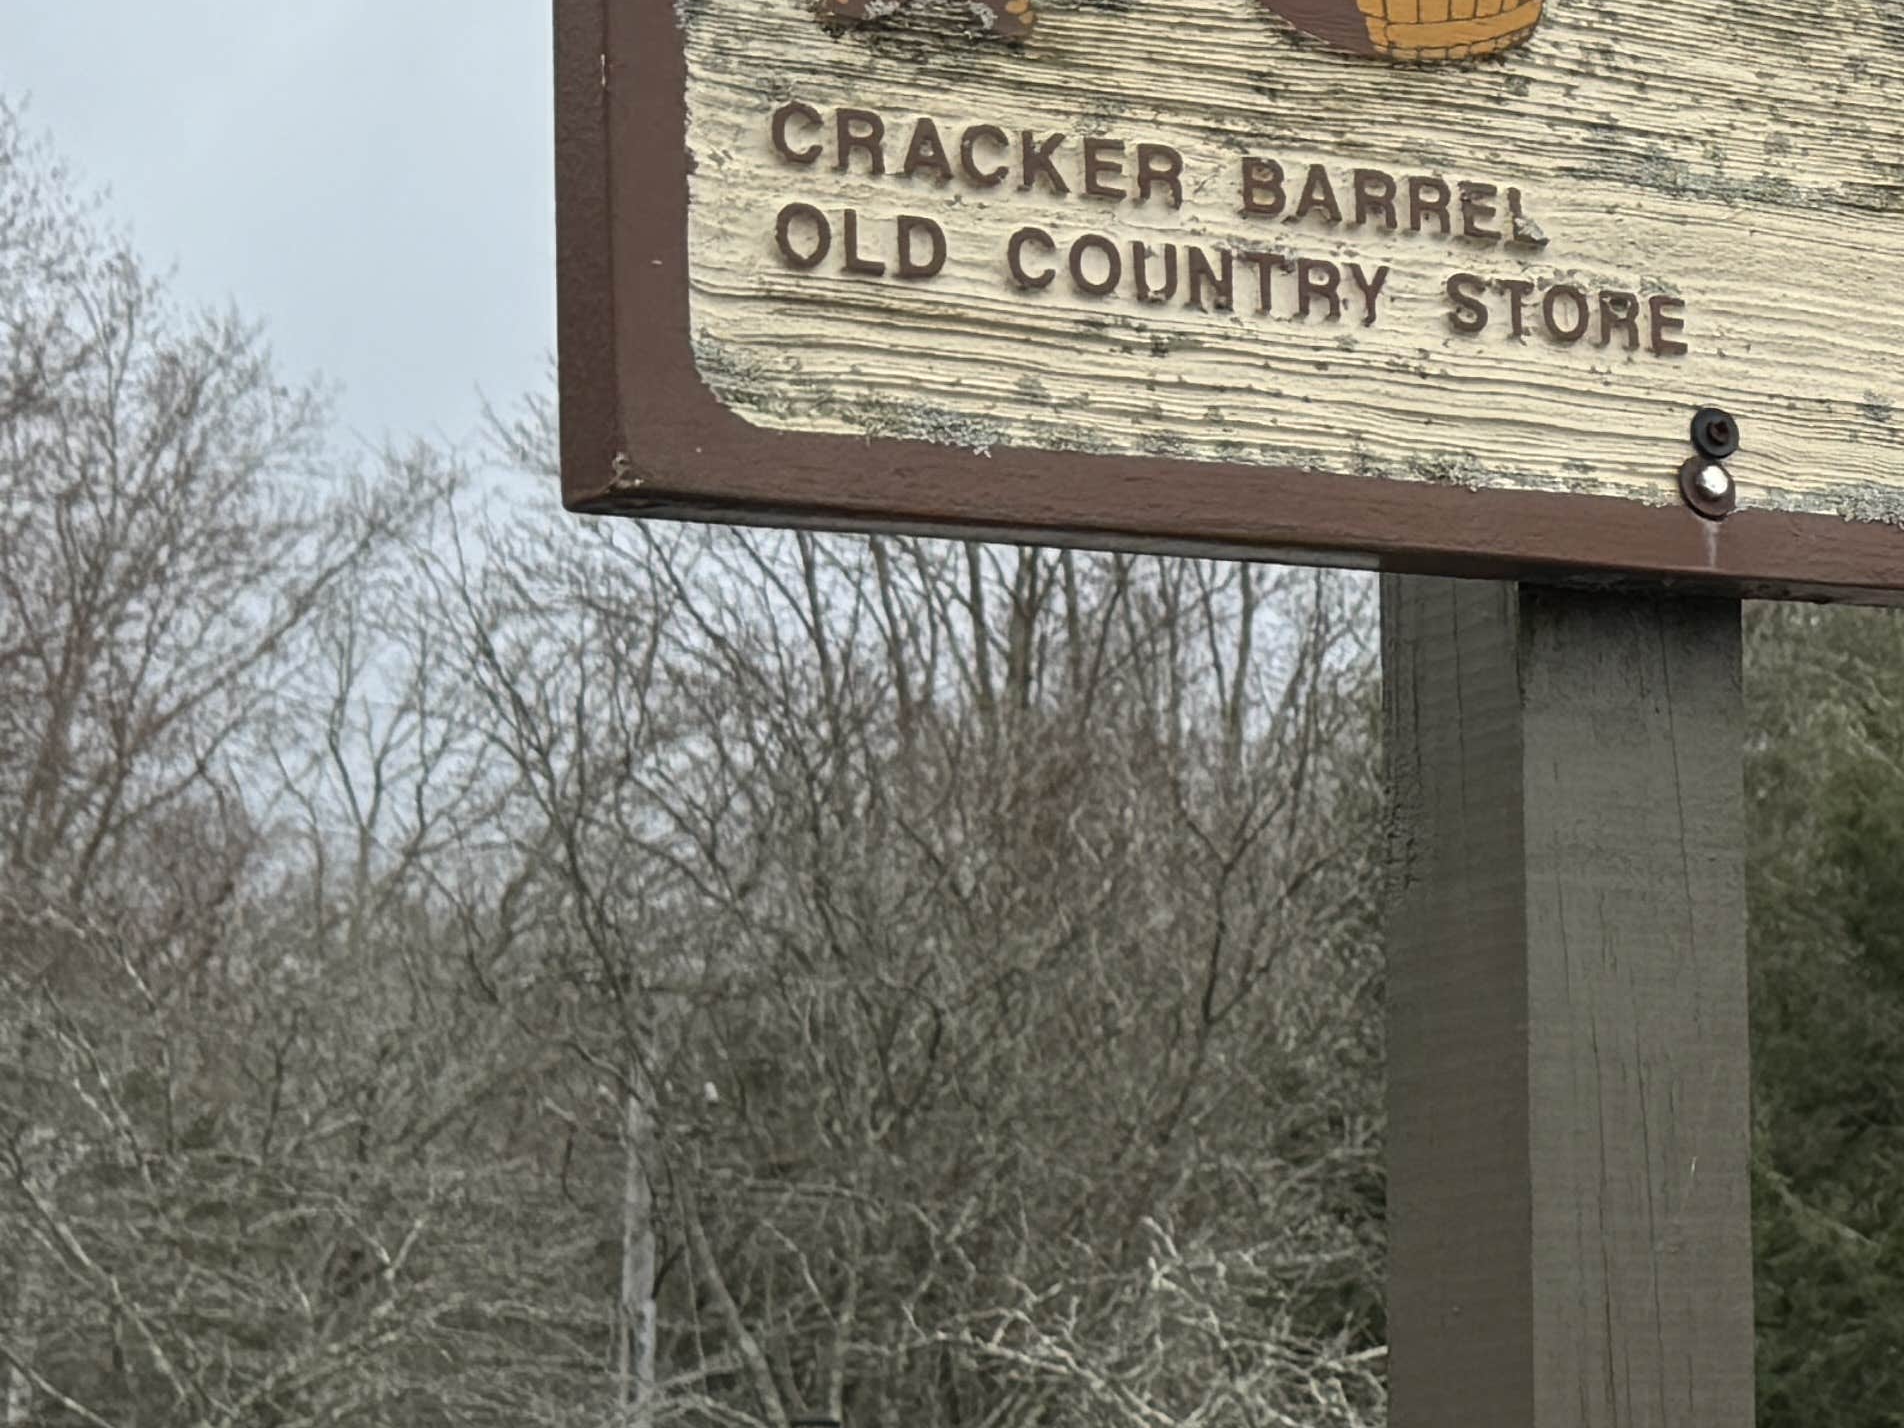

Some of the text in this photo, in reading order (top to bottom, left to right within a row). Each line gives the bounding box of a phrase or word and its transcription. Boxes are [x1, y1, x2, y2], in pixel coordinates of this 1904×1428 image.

[772, 101, 1548, 246] CRACKER BARREL
[775, 202, 1687, 355] OLD COUNTRY STORE
